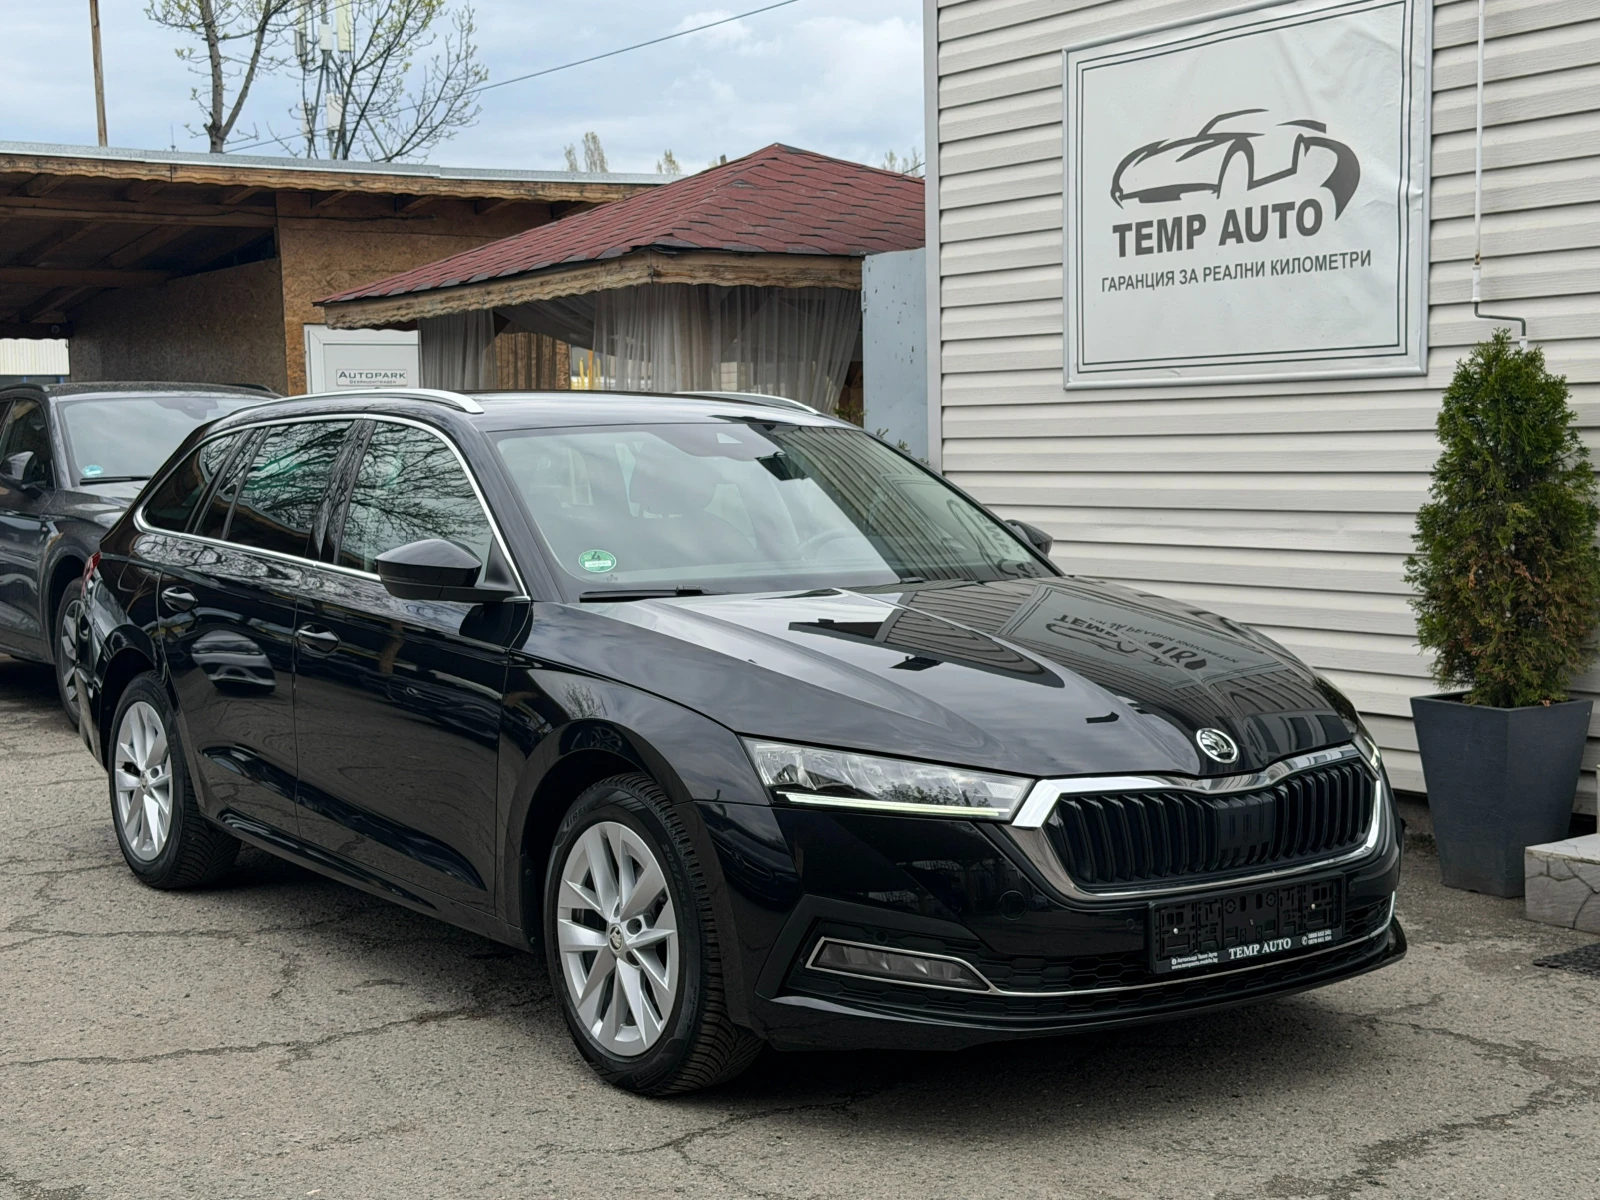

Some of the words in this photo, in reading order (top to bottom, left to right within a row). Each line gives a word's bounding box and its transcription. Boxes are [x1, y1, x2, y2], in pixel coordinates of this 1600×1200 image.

[1112, 213, 1207, 258] TEMP
[1218, 198, 1323, 246] AUTO
[1101, 270, 1175, 292] ГАРАНЦИЯ
[1179, 268, 1199, 285] ЗА
[1203, 260, 1265, 283] РЕАЛНИ
[1270, 249, 1372, 276] КИЛОМЕТРИ
[1228, 943, 1260, 959] TEMP
[1262, 938, 1292, 954] AUTO
